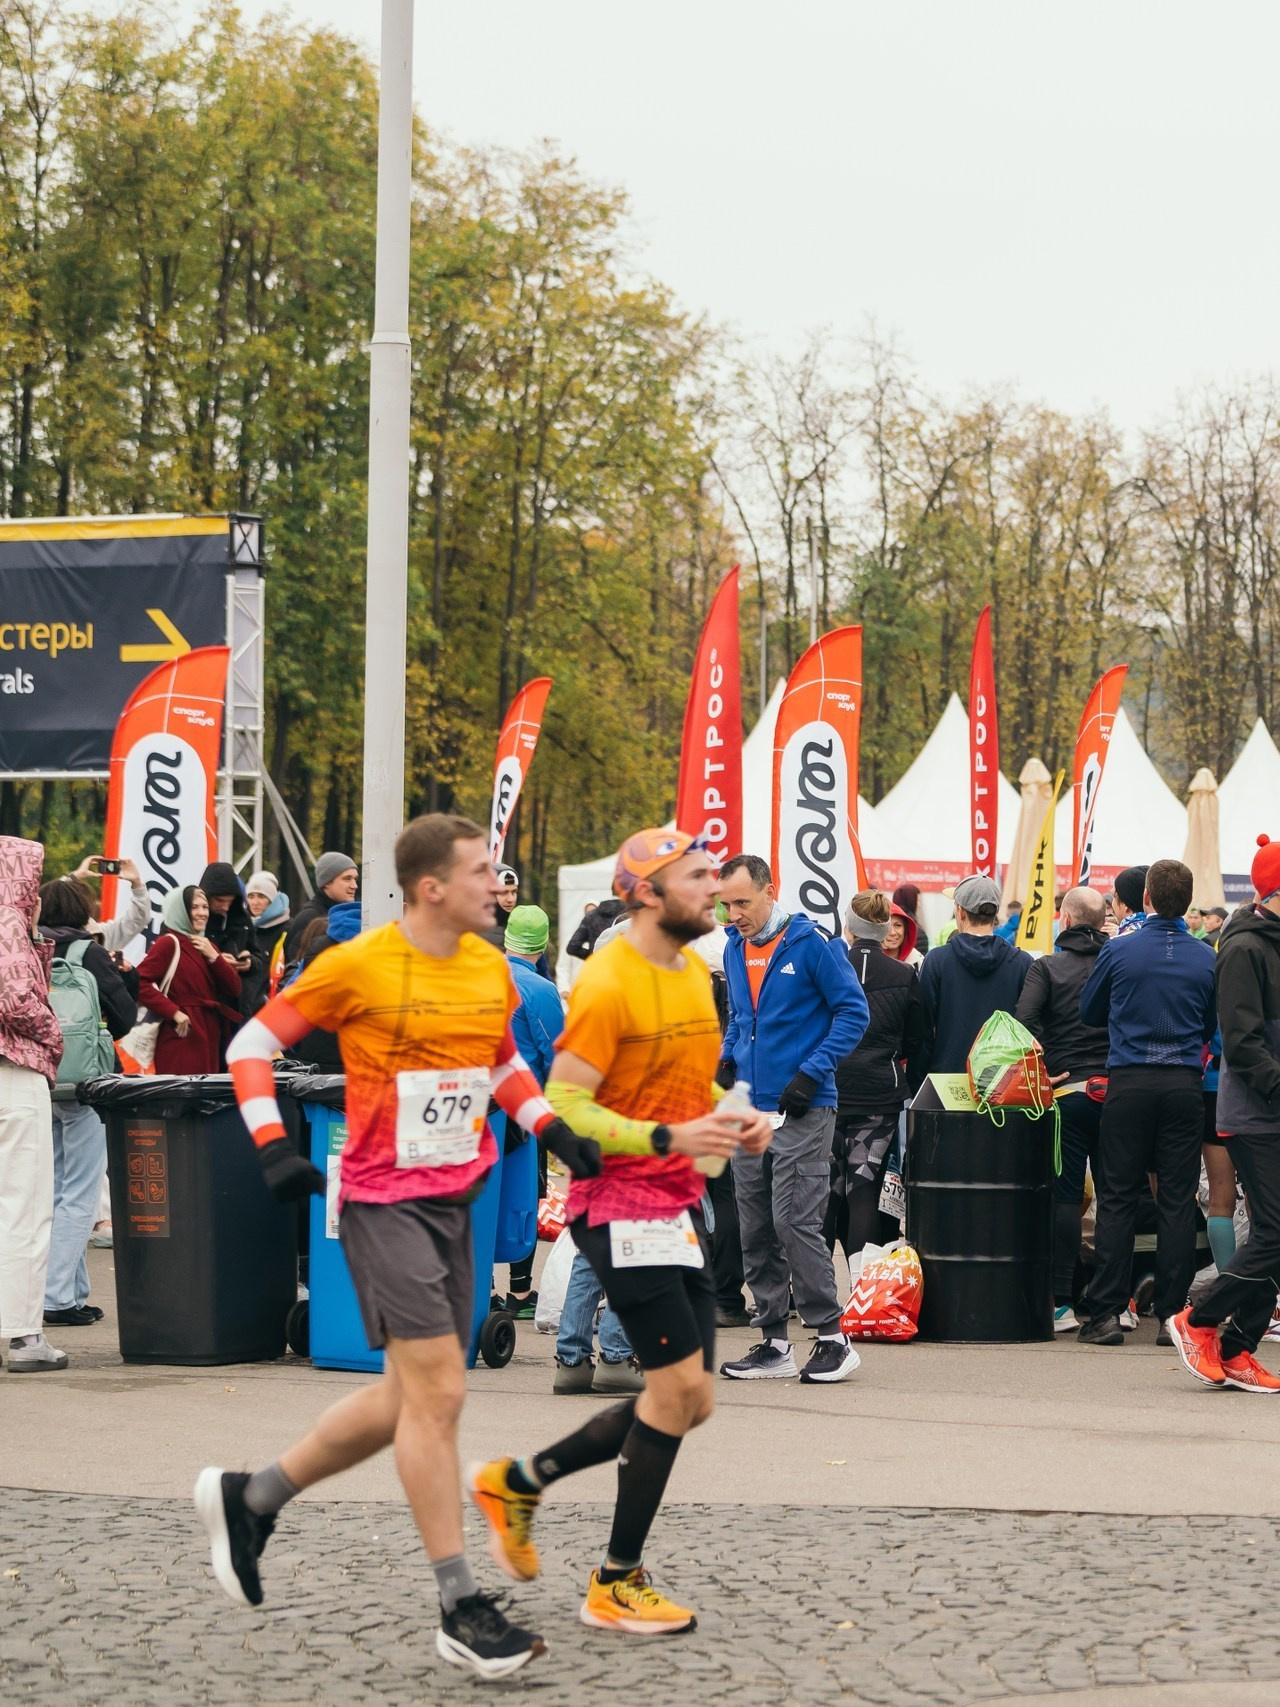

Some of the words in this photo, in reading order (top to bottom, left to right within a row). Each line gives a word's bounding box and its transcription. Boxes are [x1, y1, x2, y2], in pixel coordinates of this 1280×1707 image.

[827, 692, 851, 702] спорт
[173, 706, 206, 718] спорт
[838, 702, 856, 712] клуб
[187, 716, 215, 727] клуб
[422, 1094, 472, 1124] 679
